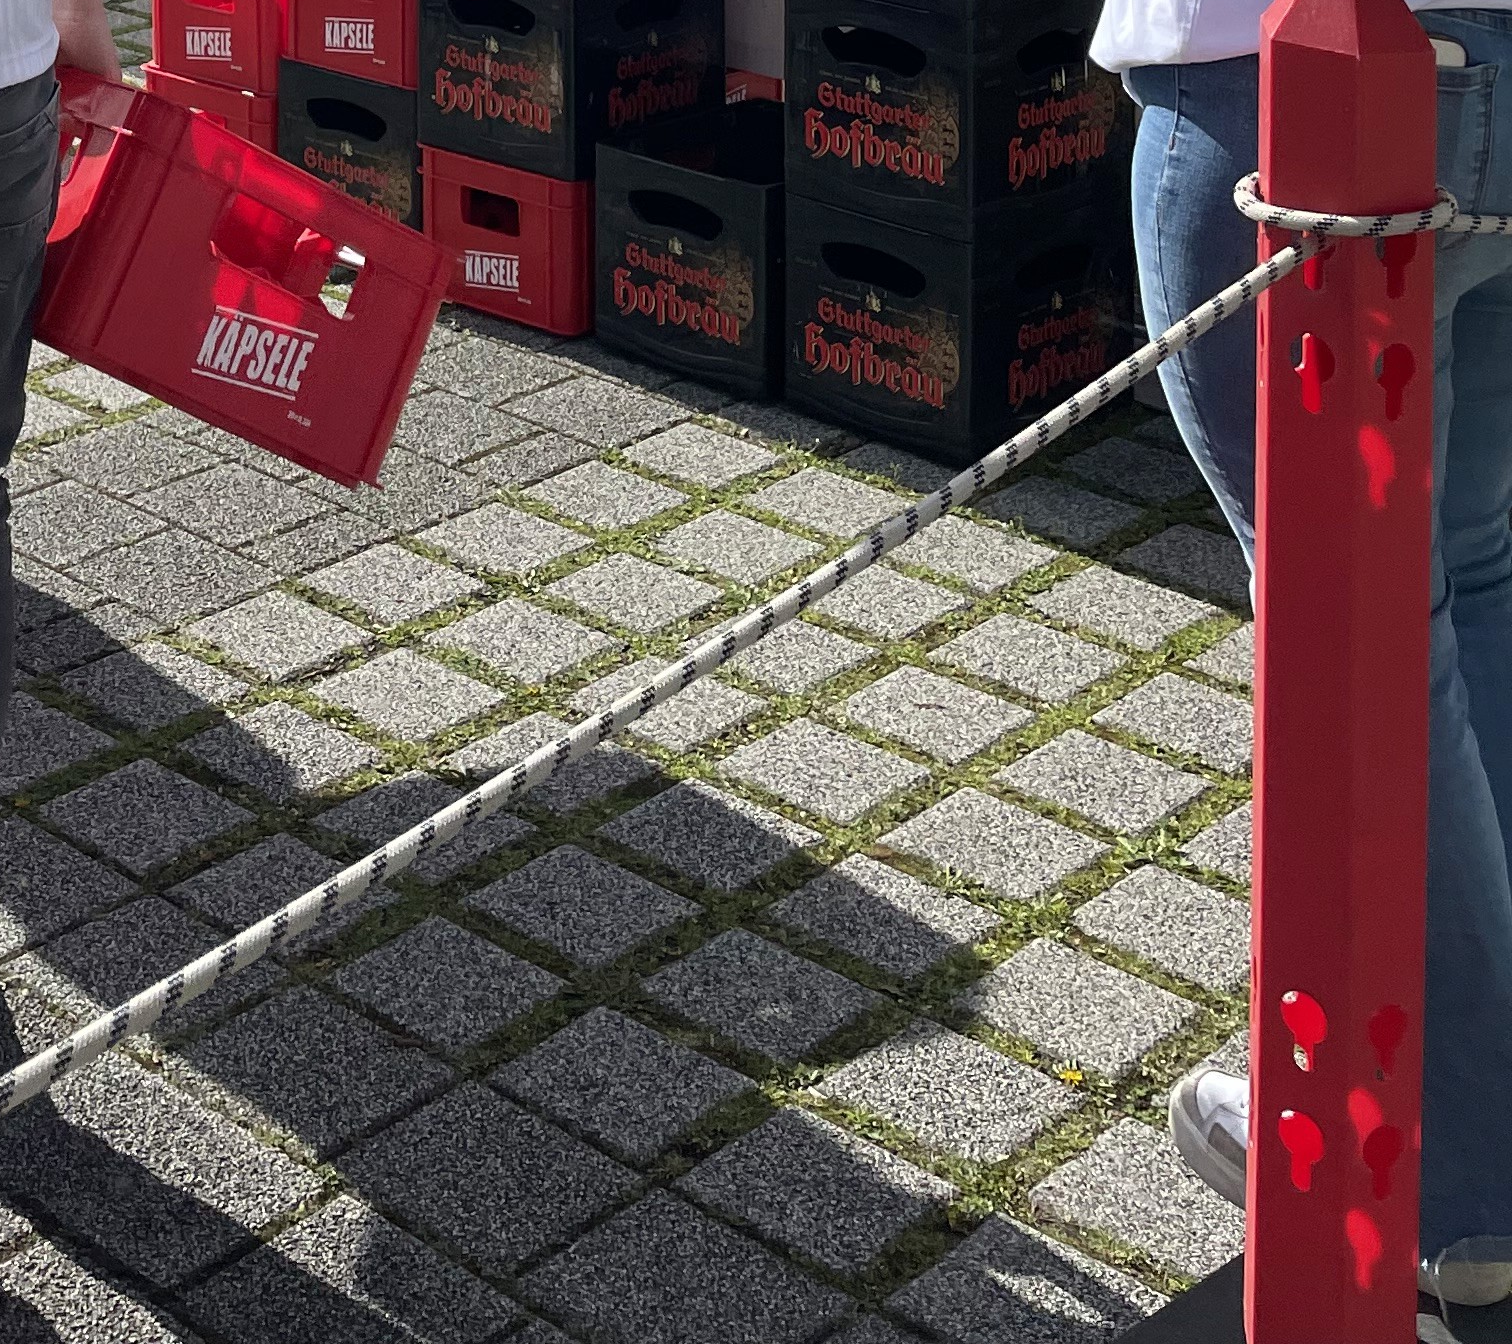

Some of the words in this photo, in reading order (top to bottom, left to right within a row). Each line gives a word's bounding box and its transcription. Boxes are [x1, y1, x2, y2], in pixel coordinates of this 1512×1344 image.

[186, 27, 232, 57] KÄPSELE
[325, 19, 374, 49] KÄPSELE
[433, 68, 552, 134] Hofbräu
[817, 81, 931, 130] Stuttgarter
[804, 107, 945, 186] Hofbräu
[1008, 119, 1106, 192] Hofbräu
[464, 254, 520, 288] KÄPSELE
[612, 265, 740, 346] Hofbräu
[196, 313, 315, 392] KÄPSELE
[804, 321, 945, 410] Hofbräu
